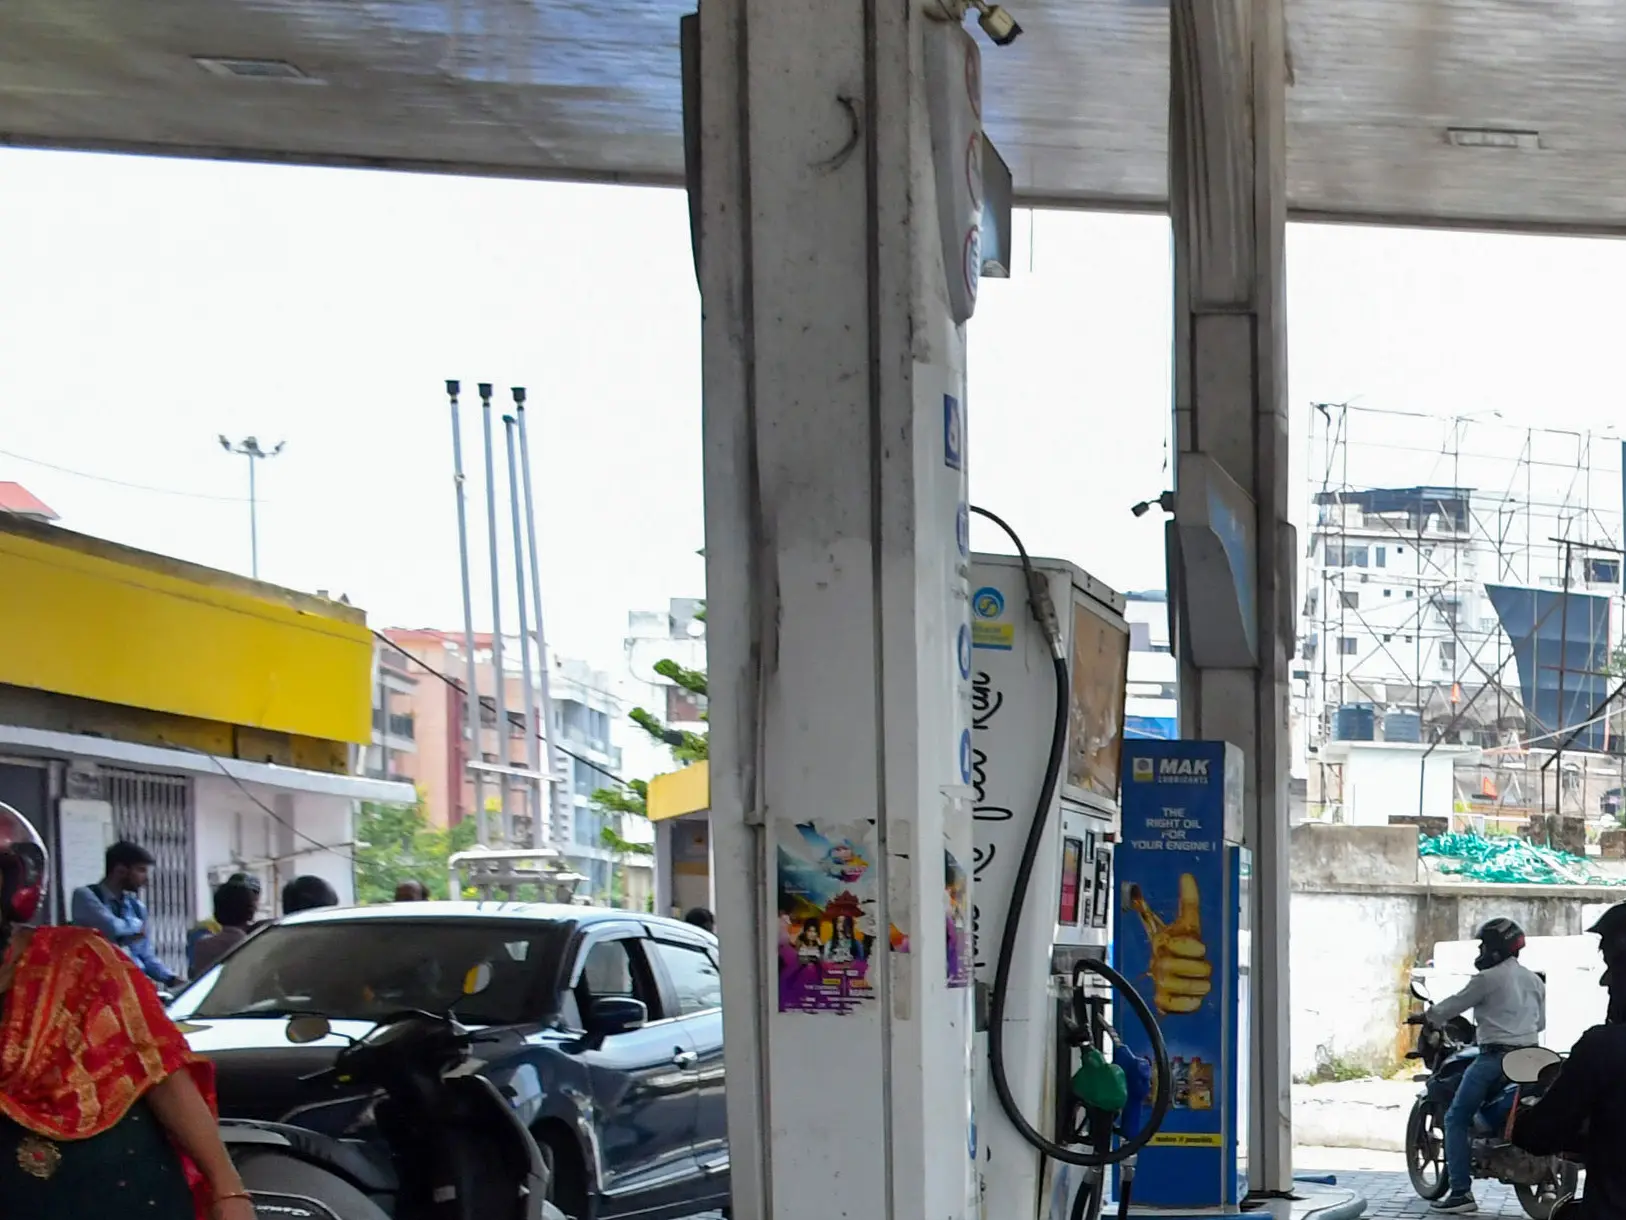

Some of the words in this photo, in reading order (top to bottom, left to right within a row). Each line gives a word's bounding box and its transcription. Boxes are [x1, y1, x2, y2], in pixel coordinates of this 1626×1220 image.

[1159, 758, 1211, 775] MAK
[1162, 807, 1187, 817] THE
[1145, 818, 1181, 828] RIGHT
[1183, 819, 1202, 829] OIL
[1161, 830, 1187, 839] FOR
[1130, 840, 1163, 850] YOUR
